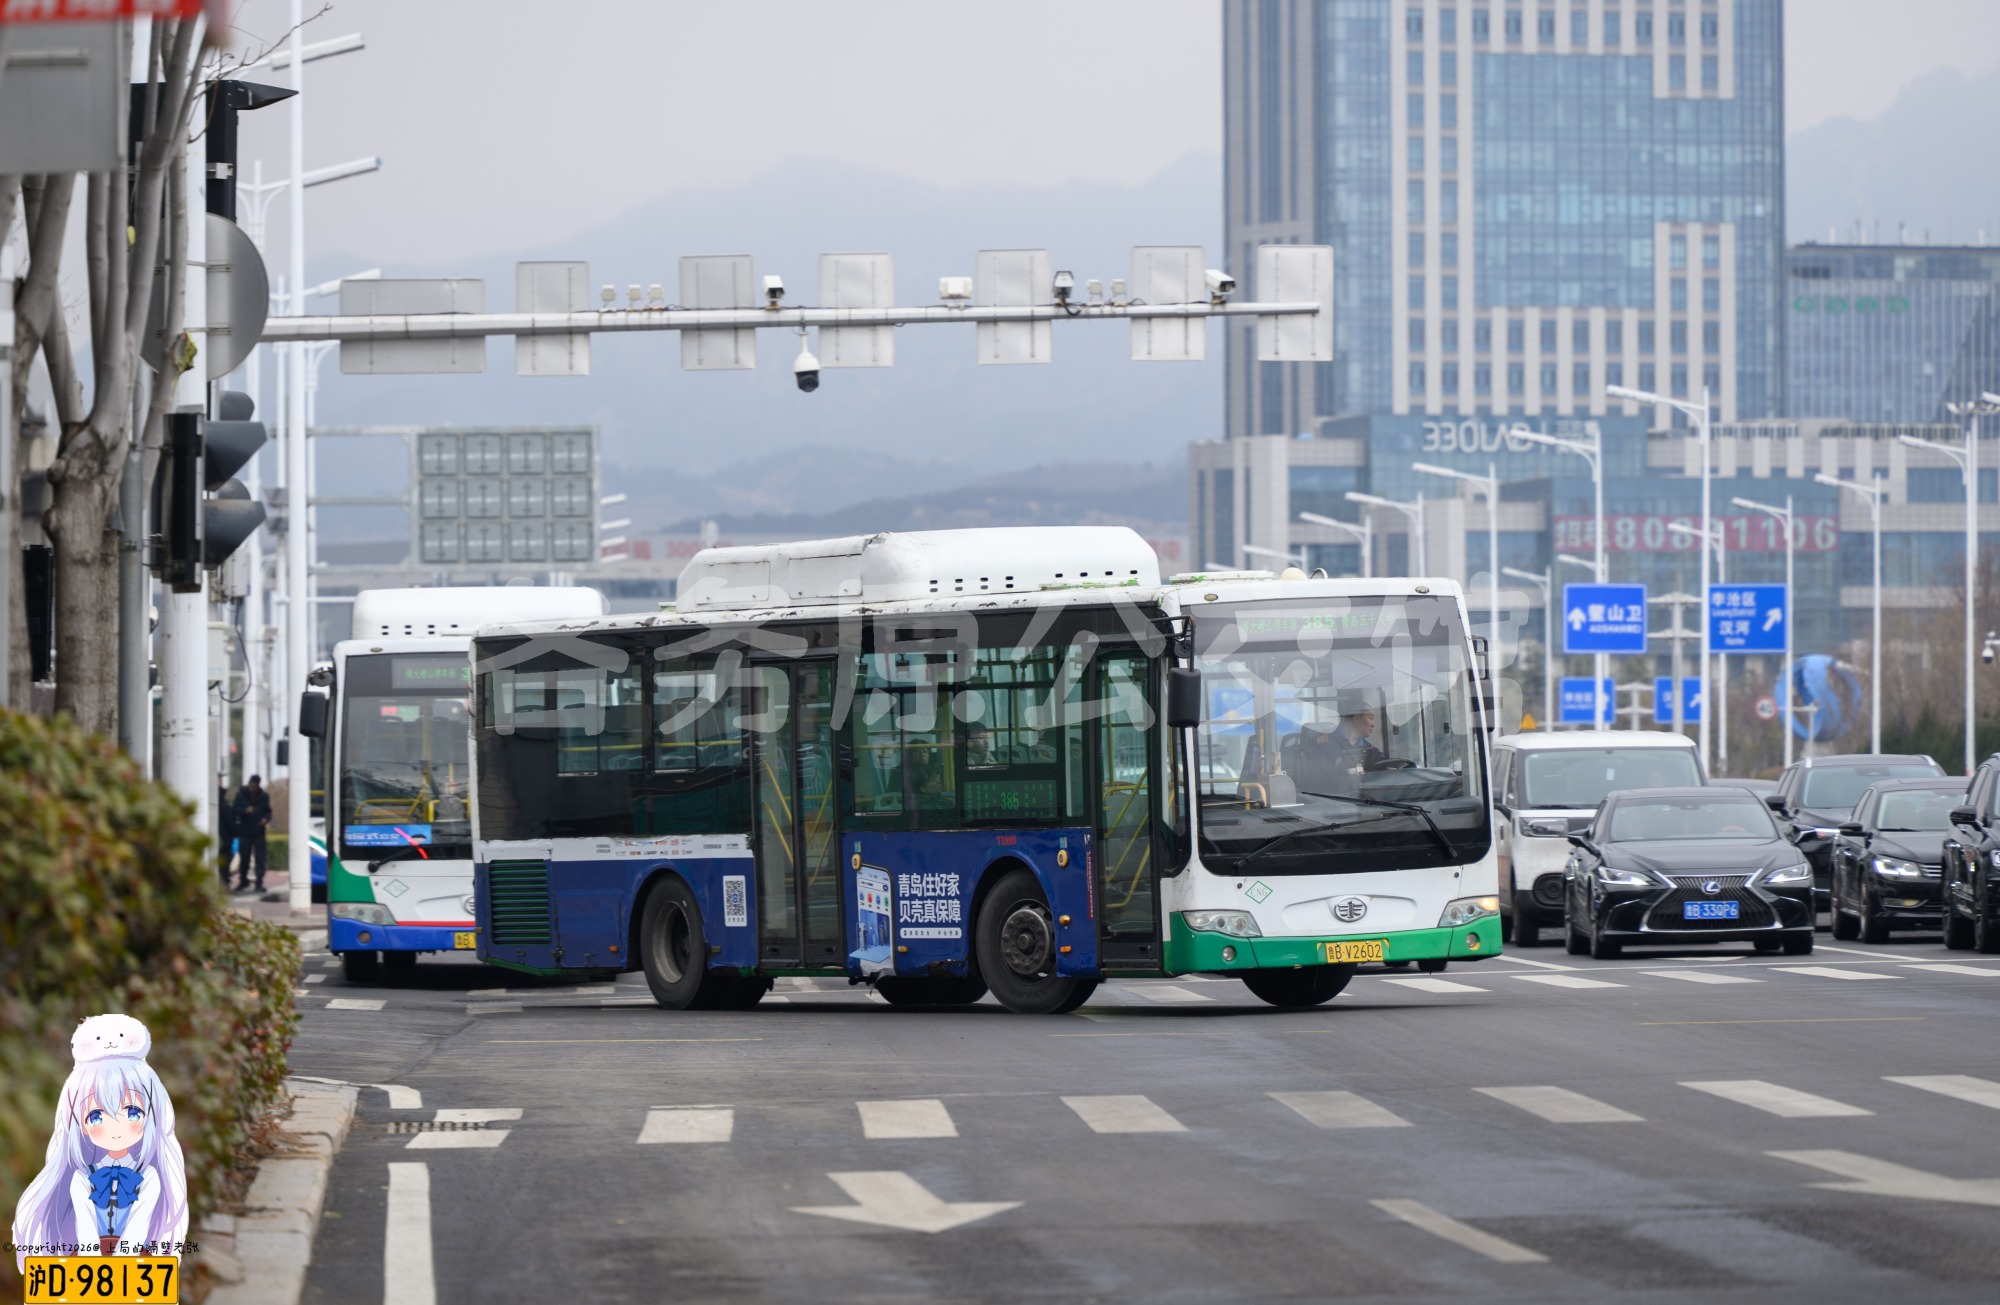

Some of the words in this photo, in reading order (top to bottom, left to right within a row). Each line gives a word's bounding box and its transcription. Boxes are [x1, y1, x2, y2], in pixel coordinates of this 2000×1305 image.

[1301, 612, 1335, 631] 385
[1000, 791, 1020, 810] 385
[898, 872, 960, 897] 青岛住好家
[1250, 887, 1268, 897] CNG
[899, 899, 961, 923] 贝壳真保障
